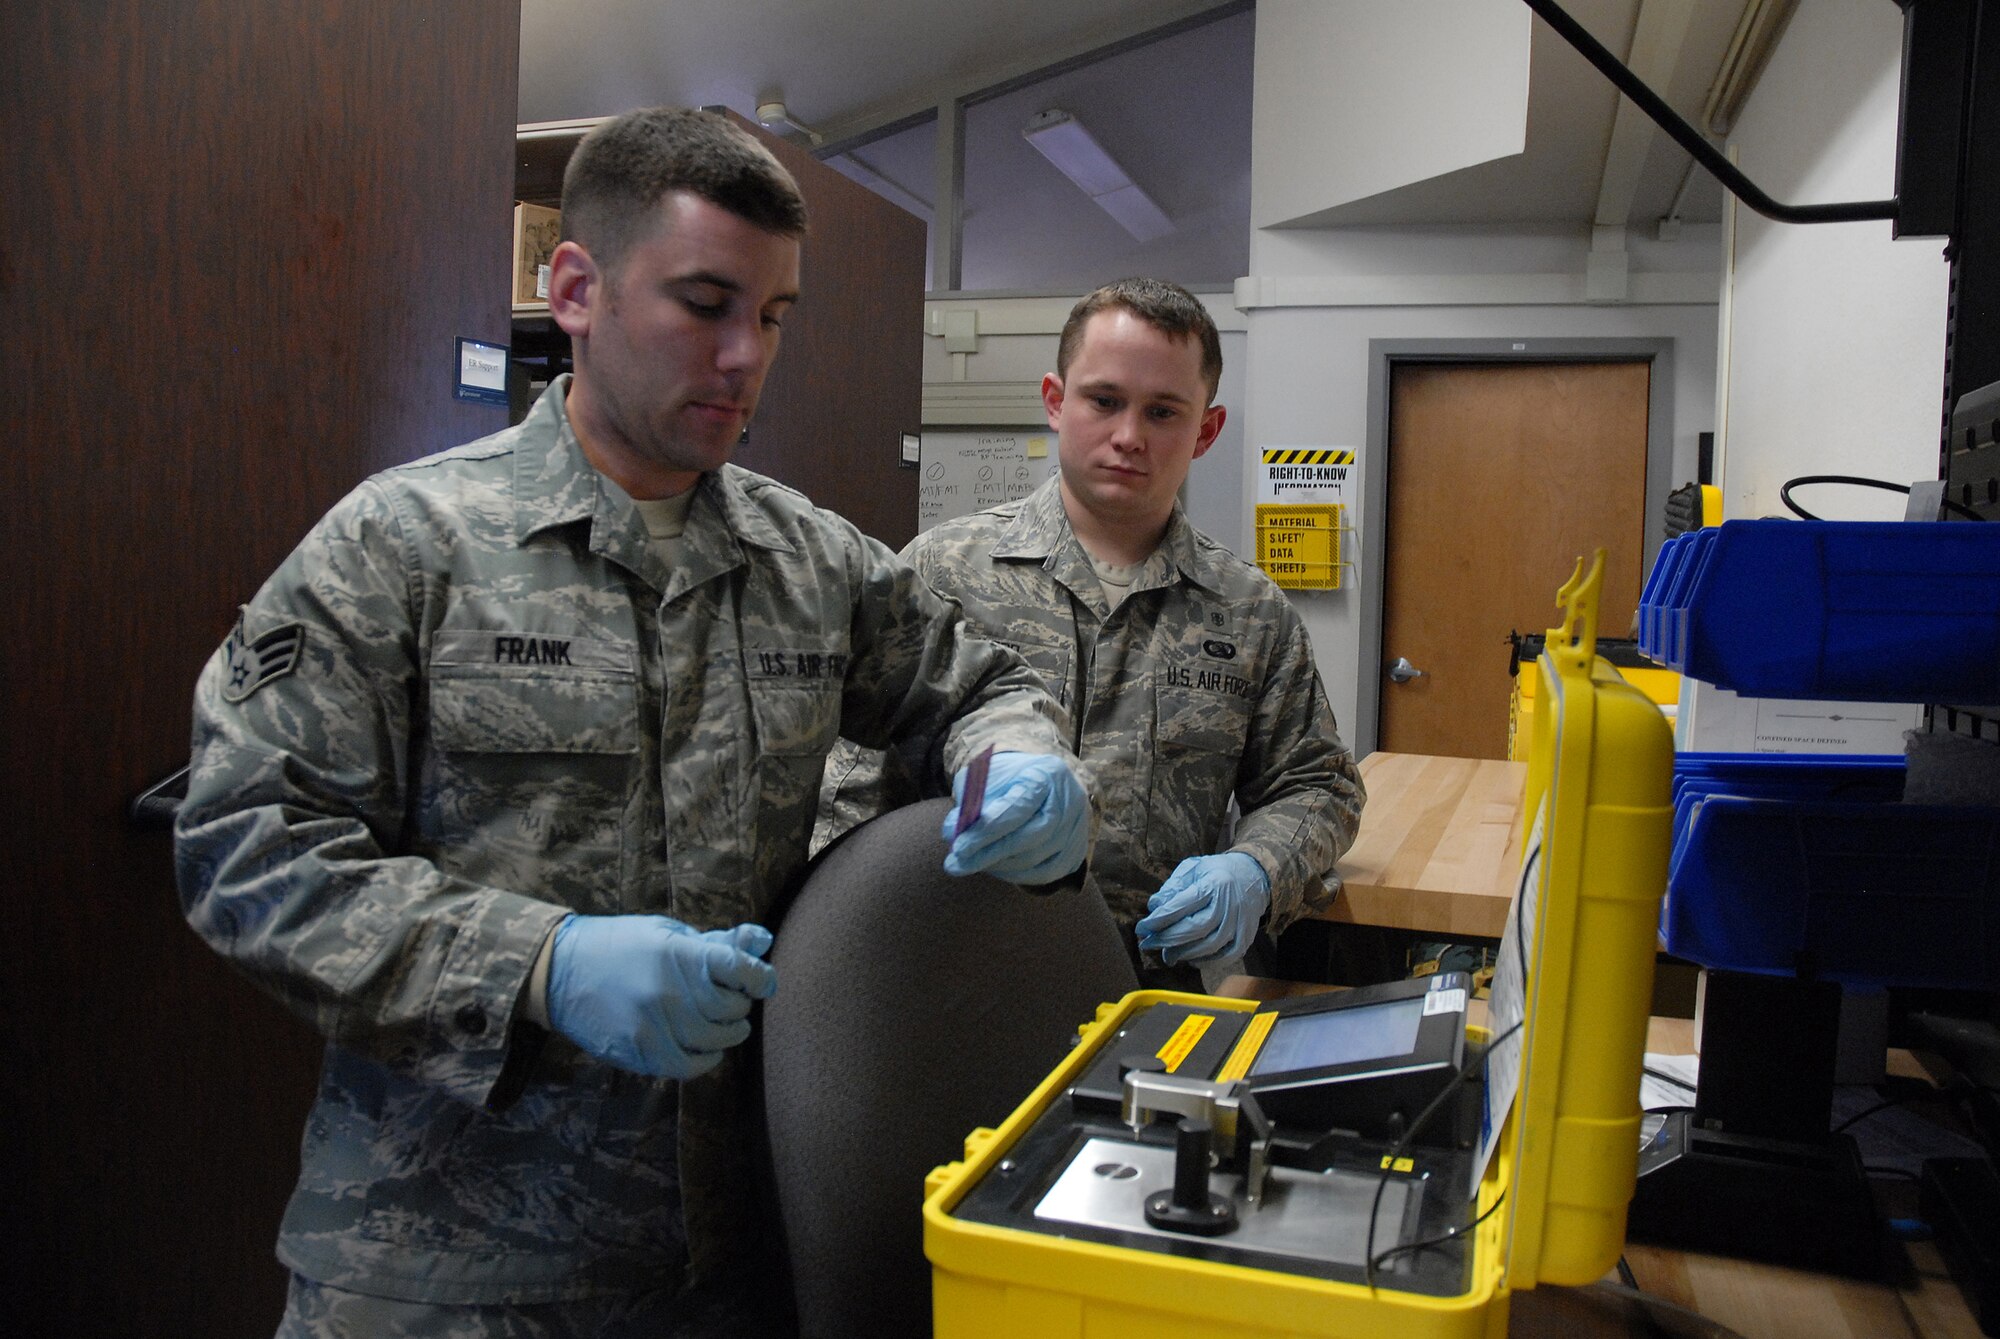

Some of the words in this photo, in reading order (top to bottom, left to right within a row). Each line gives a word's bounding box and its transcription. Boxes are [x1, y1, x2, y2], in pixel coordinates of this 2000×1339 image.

[1269, 466, 1348, 481] RIGHT-TO-KNOW
[1269, 517, 1317, 528] MATERIAL
[1269, 532, 1305, 544] SAFETY
[1270, 548, 1294, 559] DATA
[1270, 563, 1307, 574] SHEETS
[495, 636, 572, 666] FRANK
[759, 652, 792, 676] U.S.
[797, 653, 821, 679] AIR
[1167, 666, 1193, 687] U.S.
[1197, 670, 1221, 691] AIR
